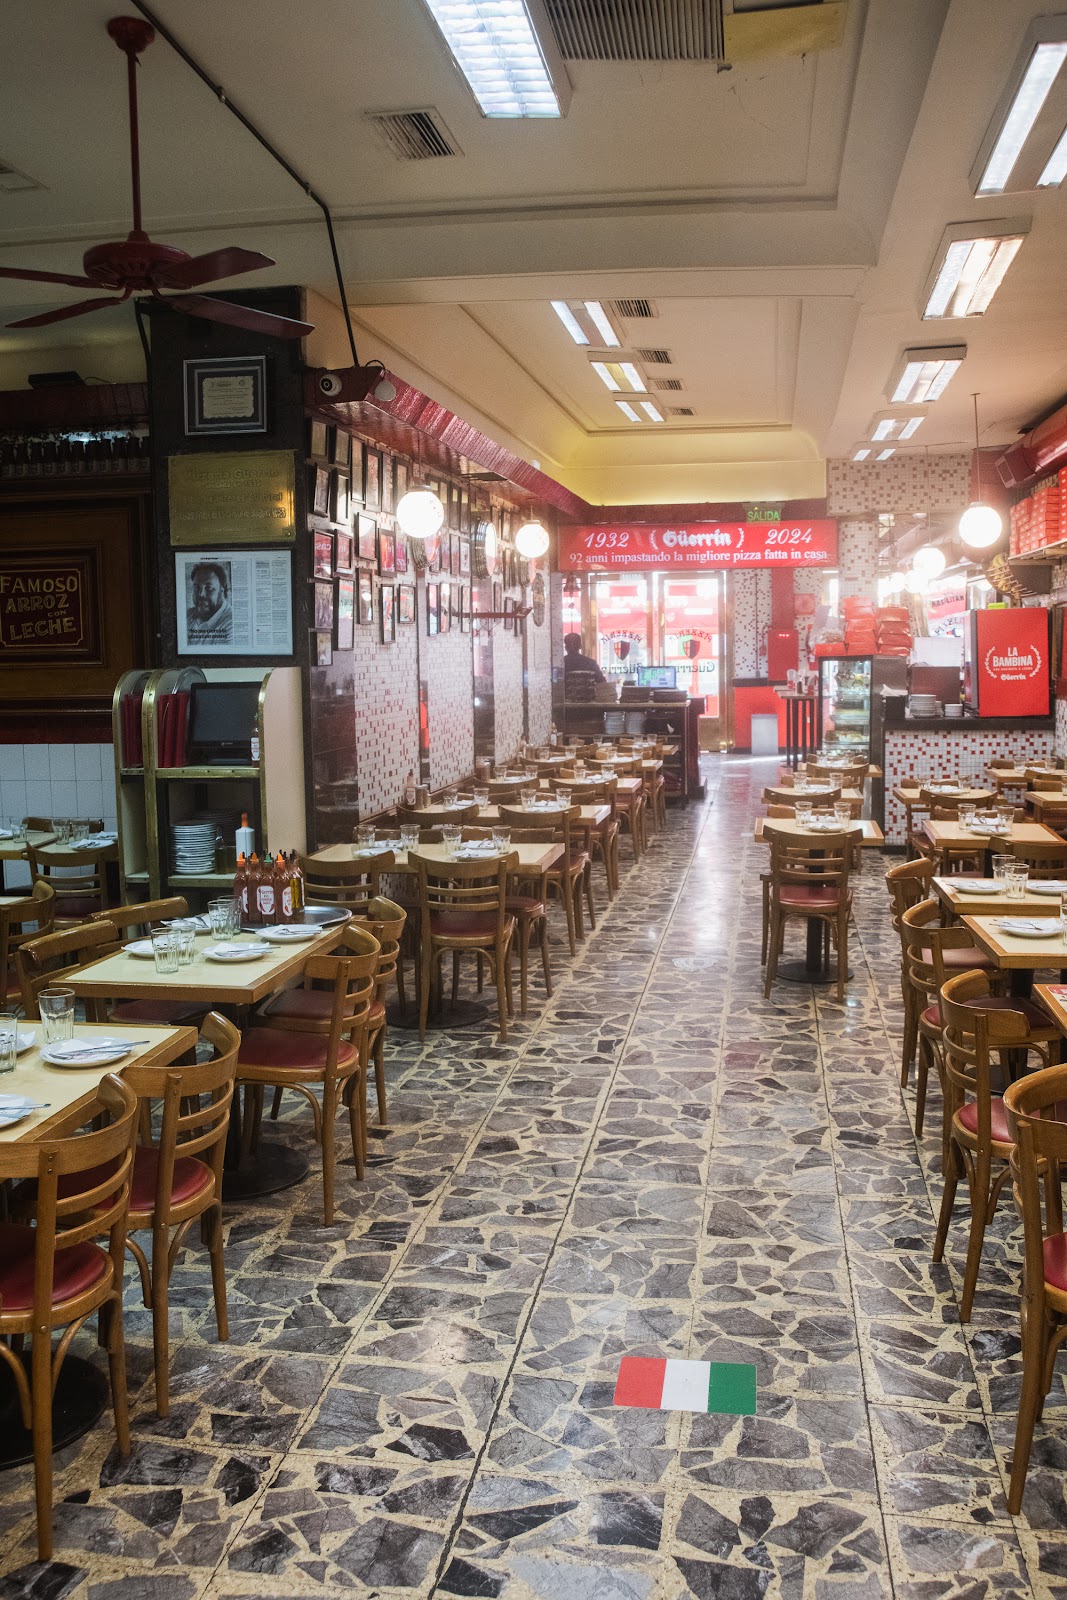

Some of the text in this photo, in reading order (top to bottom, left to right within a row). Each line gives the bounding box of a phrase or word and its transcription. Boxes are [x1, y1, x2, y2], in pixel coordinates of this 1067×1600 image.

[747, 511, 781, 521] SALIDA
[584, 531, 630, 548] 1932
[765, 528, 813, 545] 2024
[569, 548, 827, 565] 92 anni impastando la migliore pizza fatta in casa
[0, 575, 78, 594] FAMOSO
[5, 593, 70, 613] ARROZ
[47, 609, 67, 617] CON
[9, 616, 77, 641] LECHE
[1007, 646, 1019, 657] LA
[992, 655, 1033, 667] BAMBINA
